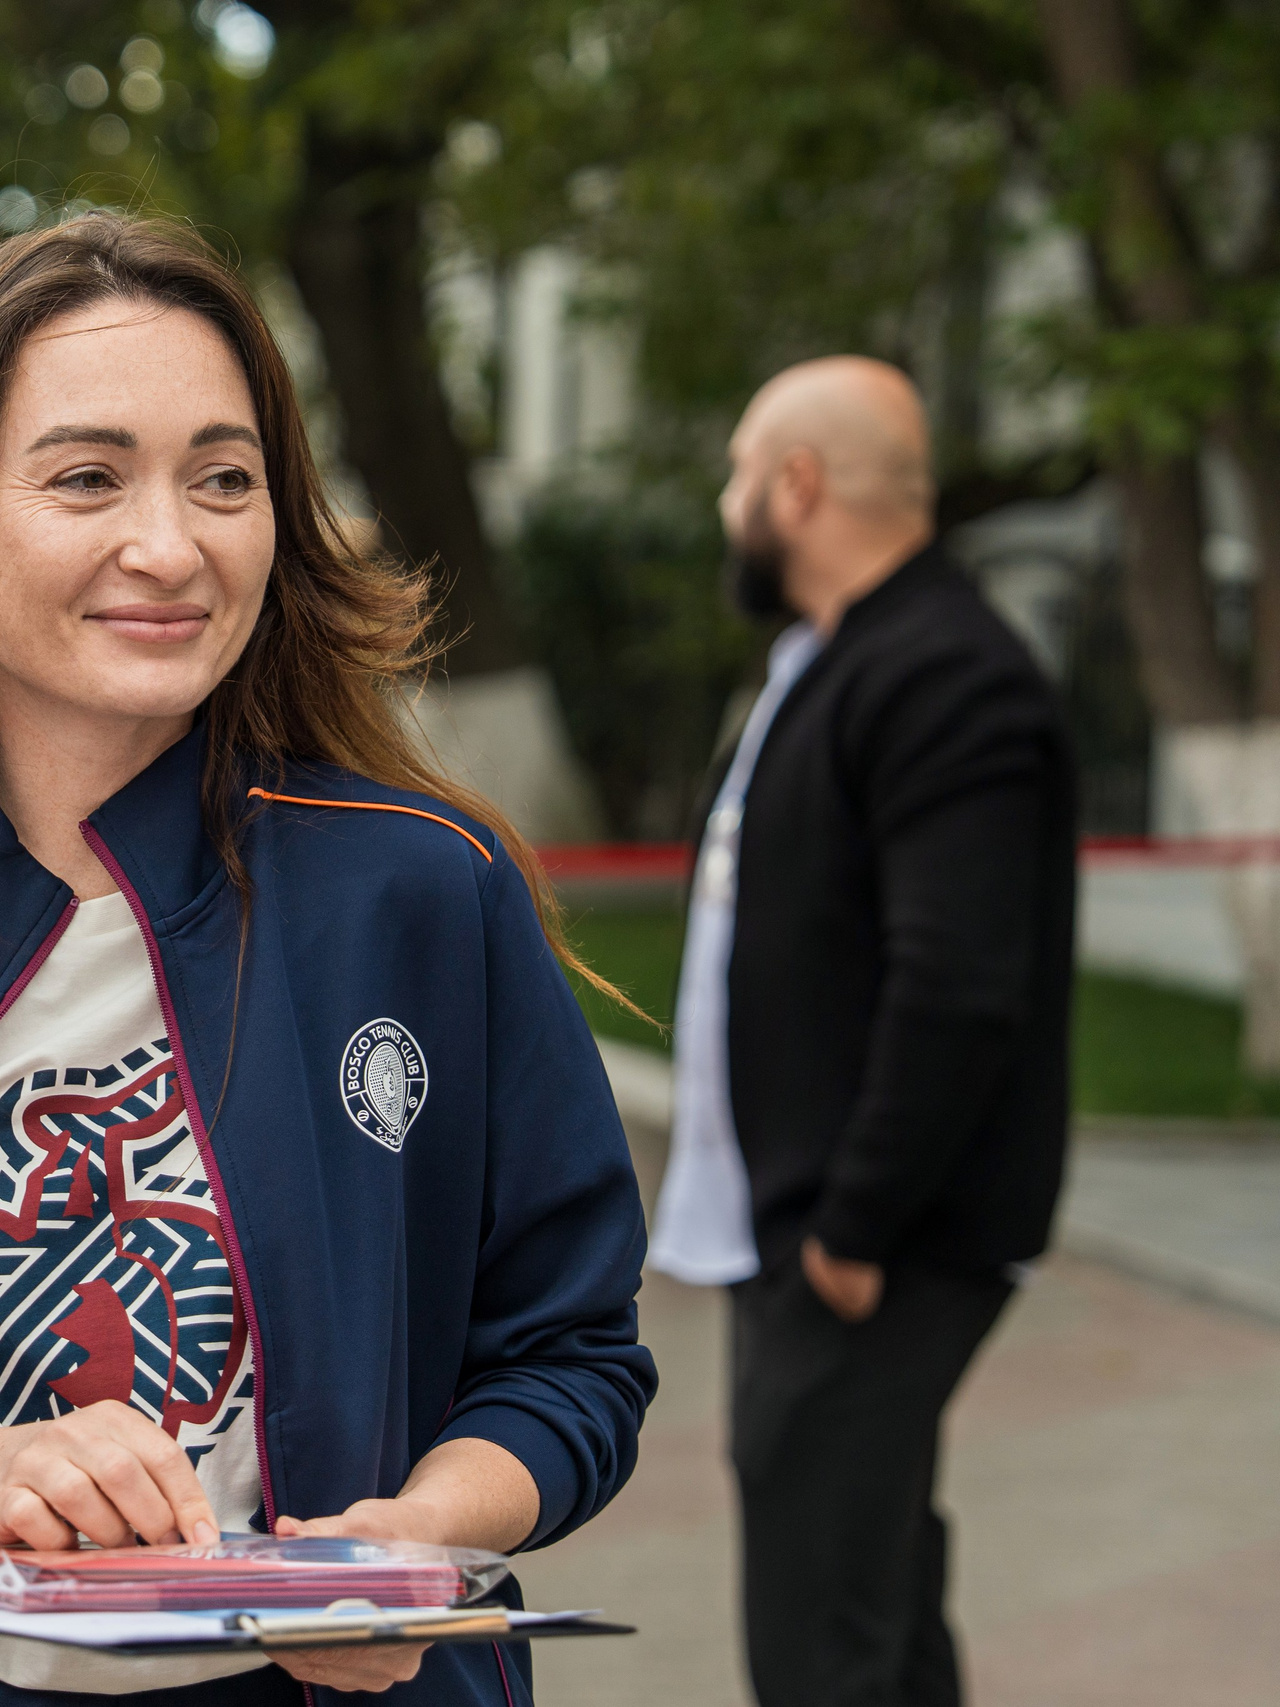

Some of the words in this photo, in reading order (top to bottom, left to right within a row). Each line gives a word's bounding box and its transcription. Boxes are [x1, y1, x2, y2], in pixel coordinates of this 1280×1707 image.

[347, 1037, 370, 1091] BOSCO
[369, 1025, 402, 1044] TENNIS
[400, 1041, 420, 1075] CLUB
